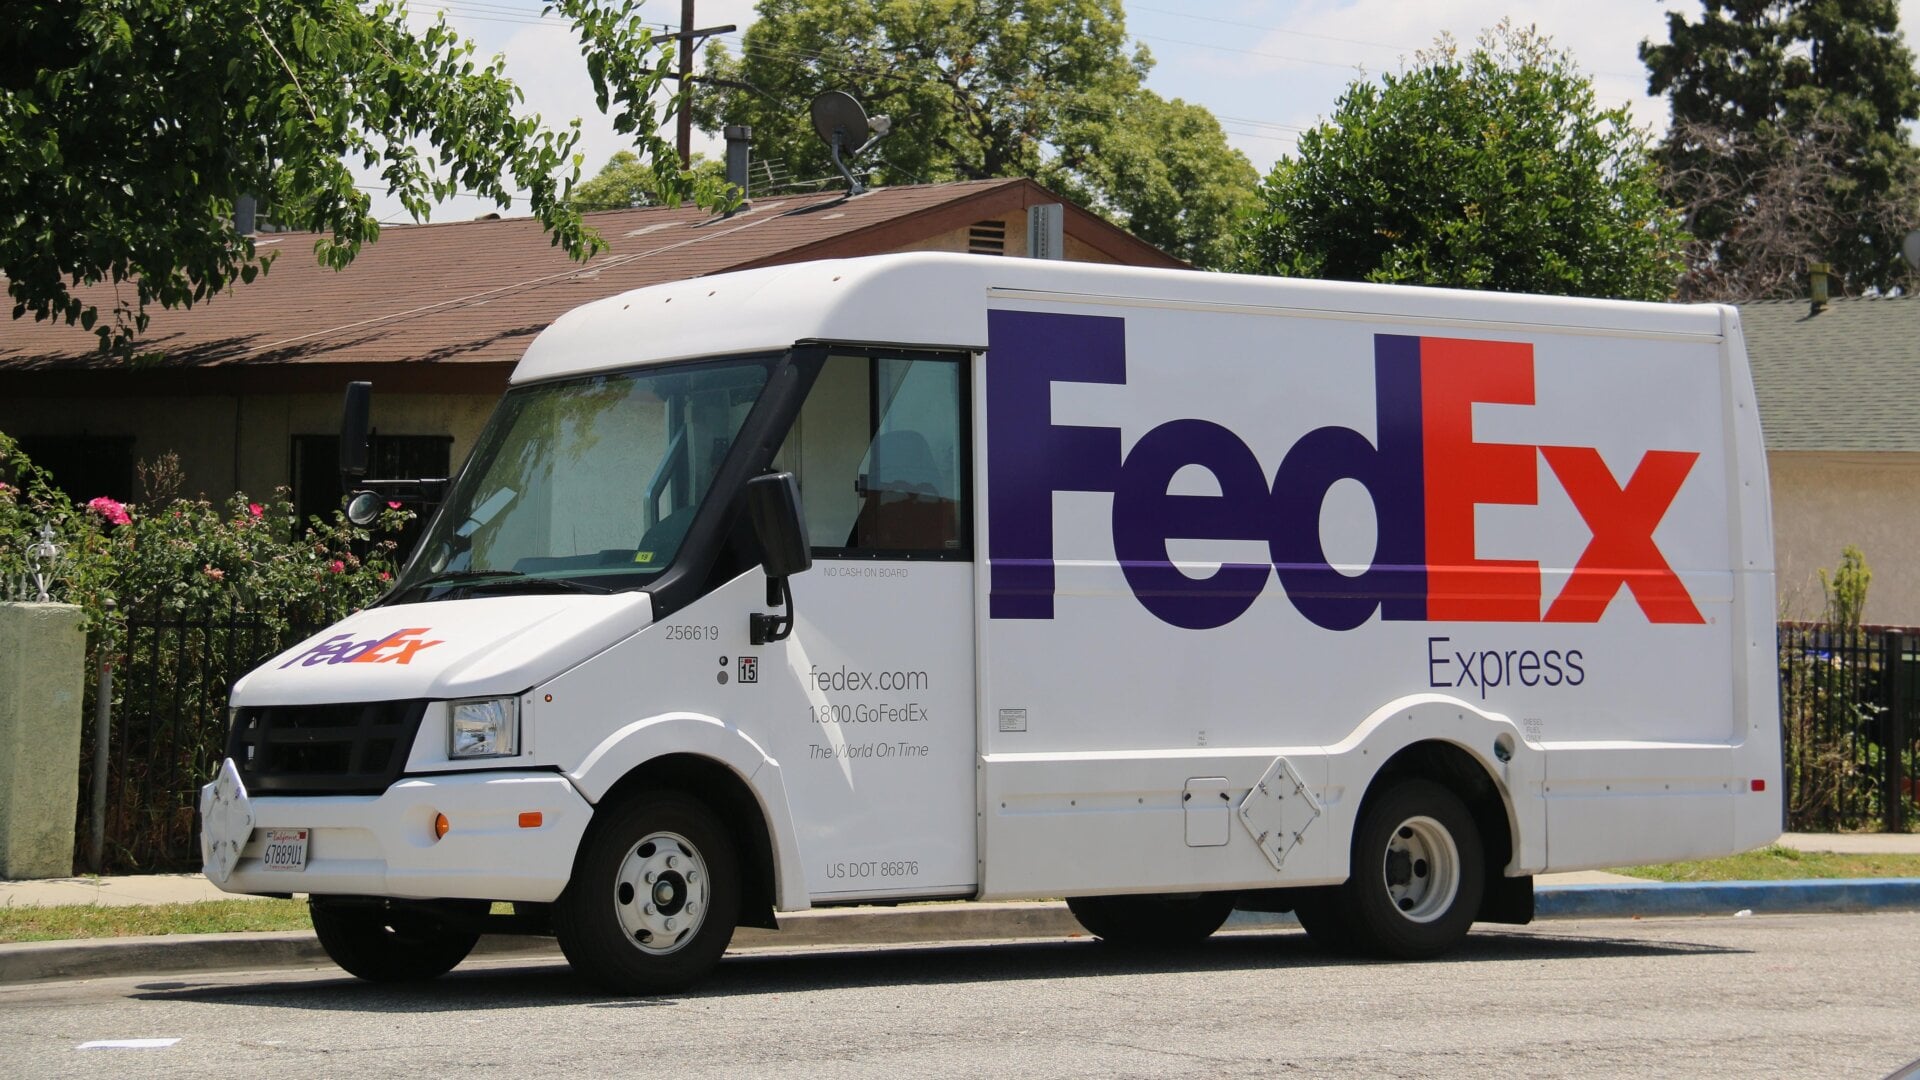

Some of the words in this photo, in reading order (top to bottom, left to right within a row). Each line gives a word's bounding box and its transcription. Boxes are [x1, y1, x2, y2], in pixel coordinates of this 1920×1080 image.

[987, 308, 1707, 632] FedEx
[823, 567, 837, 577] NO
[839, 567, 862, 577] CASH
[864, 567, 877, 578] ON
[879, 568, 909, 578] BOARD
[665, 625, 719, 641] 256619
[277, 627, 446, 670] FedEx
[741, 663, 756, 681] 15
[808, 664, 929, 691] fedex.com
[1428, 636, 1585, 700] Express
[808, 703, 929, 723] 1.800.GoFedEx
[808, 744, 833, 759] The
[835, 743, 874, 758] World
[876, 742, 896, 758] On
[898, 742, 929, 757] Time
[826, 862, 845, 879] US
[849, 861, 878, 878] DOT
[880, 860, 919, 877] 86876
